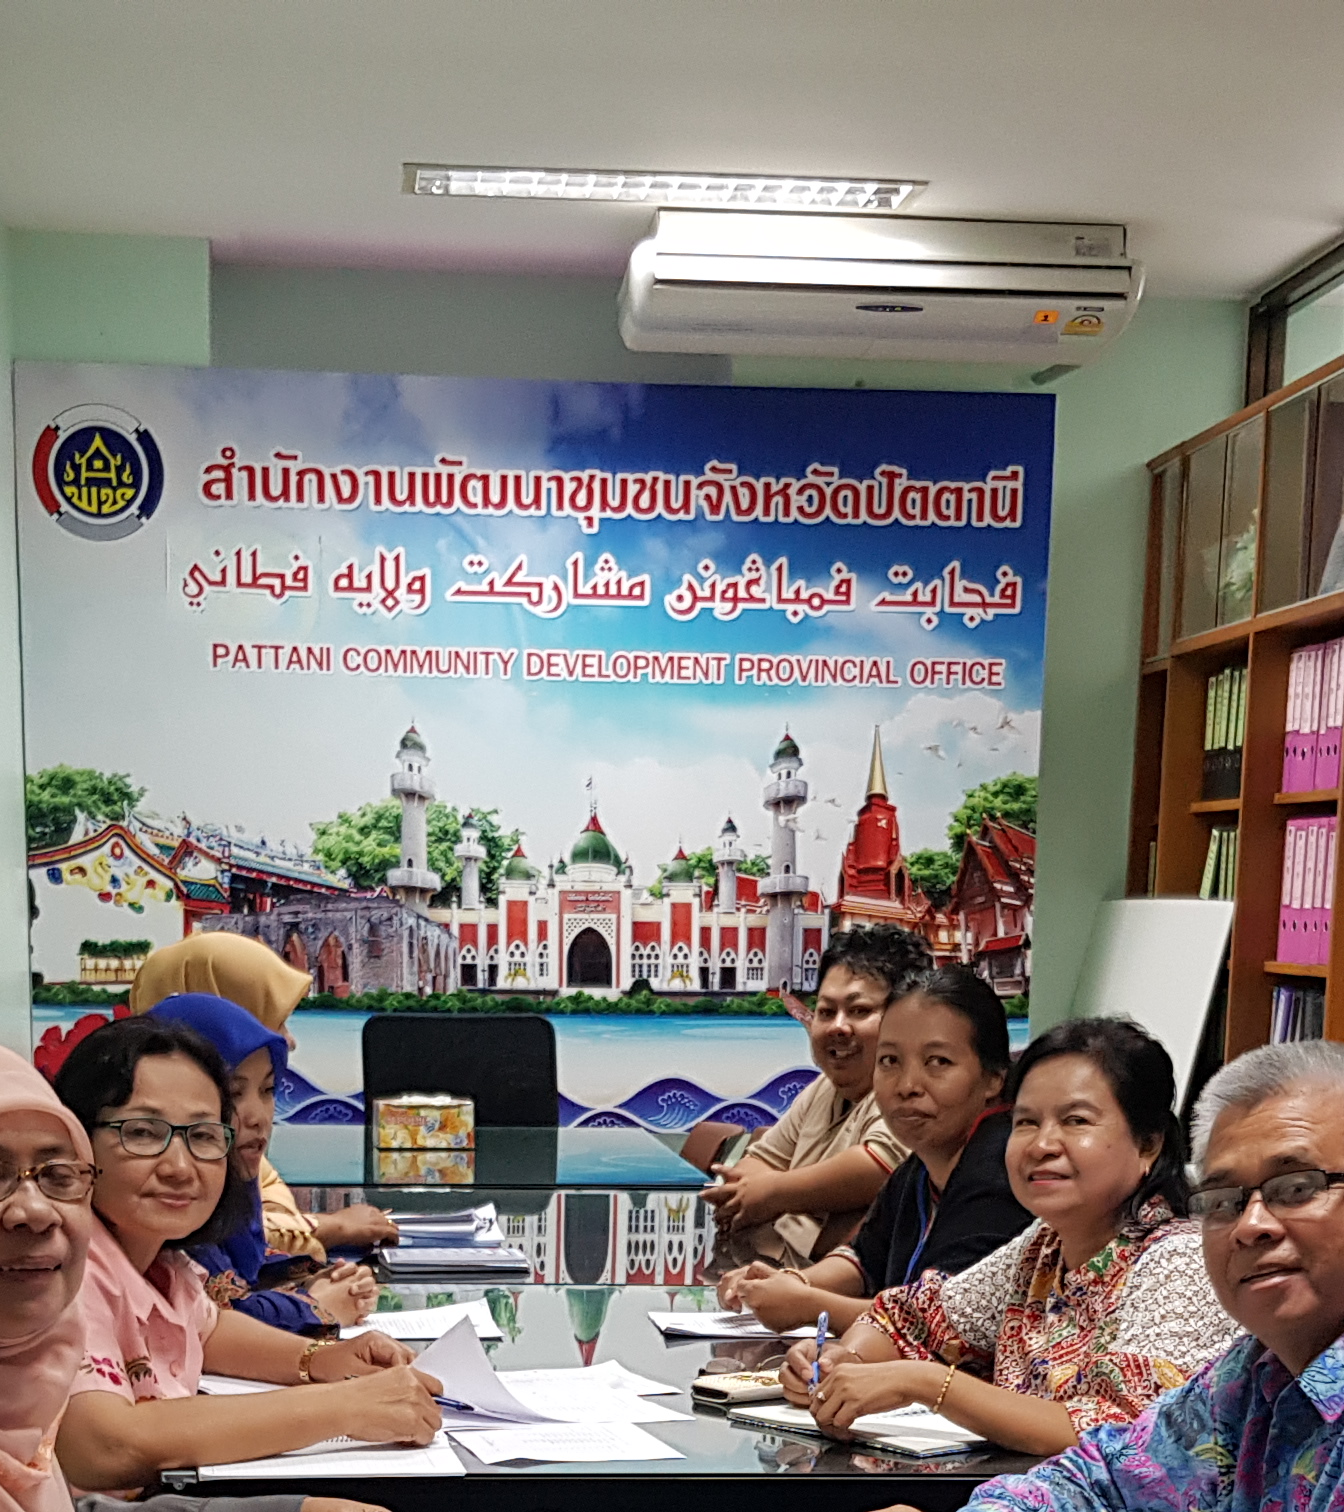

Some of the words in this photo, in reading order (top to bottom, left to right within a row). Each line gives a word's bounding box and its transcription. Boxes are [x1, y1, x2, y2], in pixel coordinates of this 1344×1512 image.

[201, 445, 1021, 530] สำนักงานพัฒนาชุมชนจังหวัดปัตตานี
[212, 643, 332, 671] PATTANI
[342, 646, 515, 675] COMMUNITY
[526, 651, 727, 682] DEVELOPMENT
[738, 656, 900, 686] PROVINCIAL
[909, 659, 1003, 687] OFFICE
